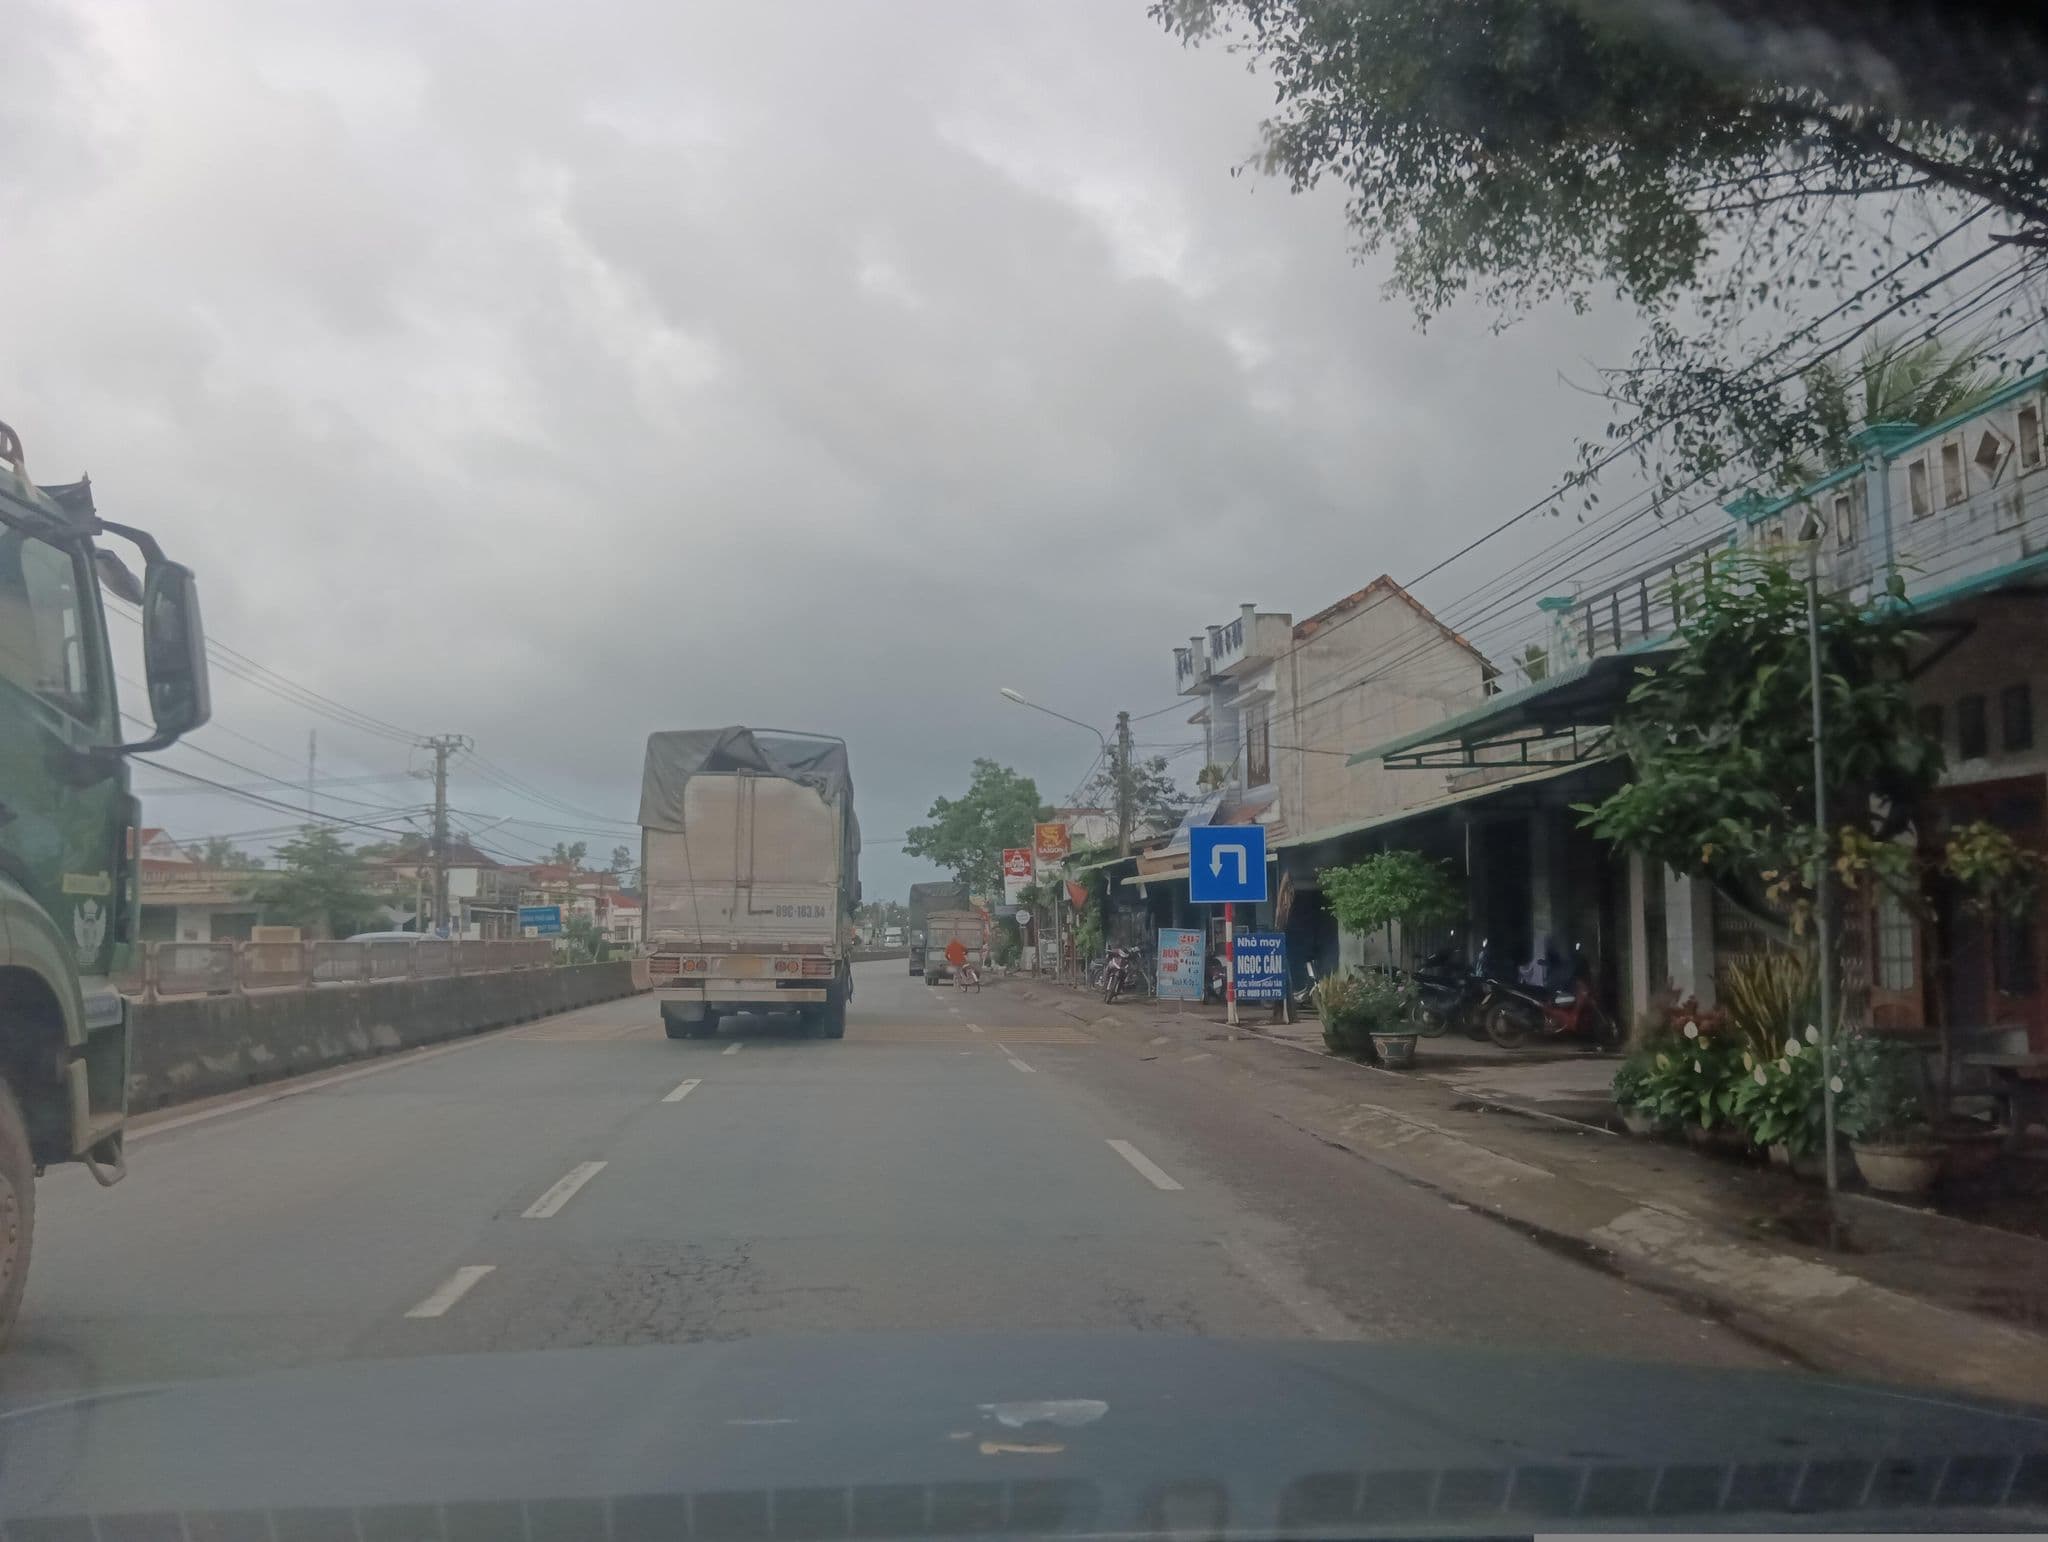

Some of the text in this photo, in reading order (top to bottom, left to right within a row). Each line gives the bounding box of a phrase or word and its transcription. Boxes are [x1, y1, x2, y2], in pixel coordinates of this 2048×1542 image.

[1237, 937, 1281, 948] Nhà may
[1237, 955, 1261, 978] NGỌC
